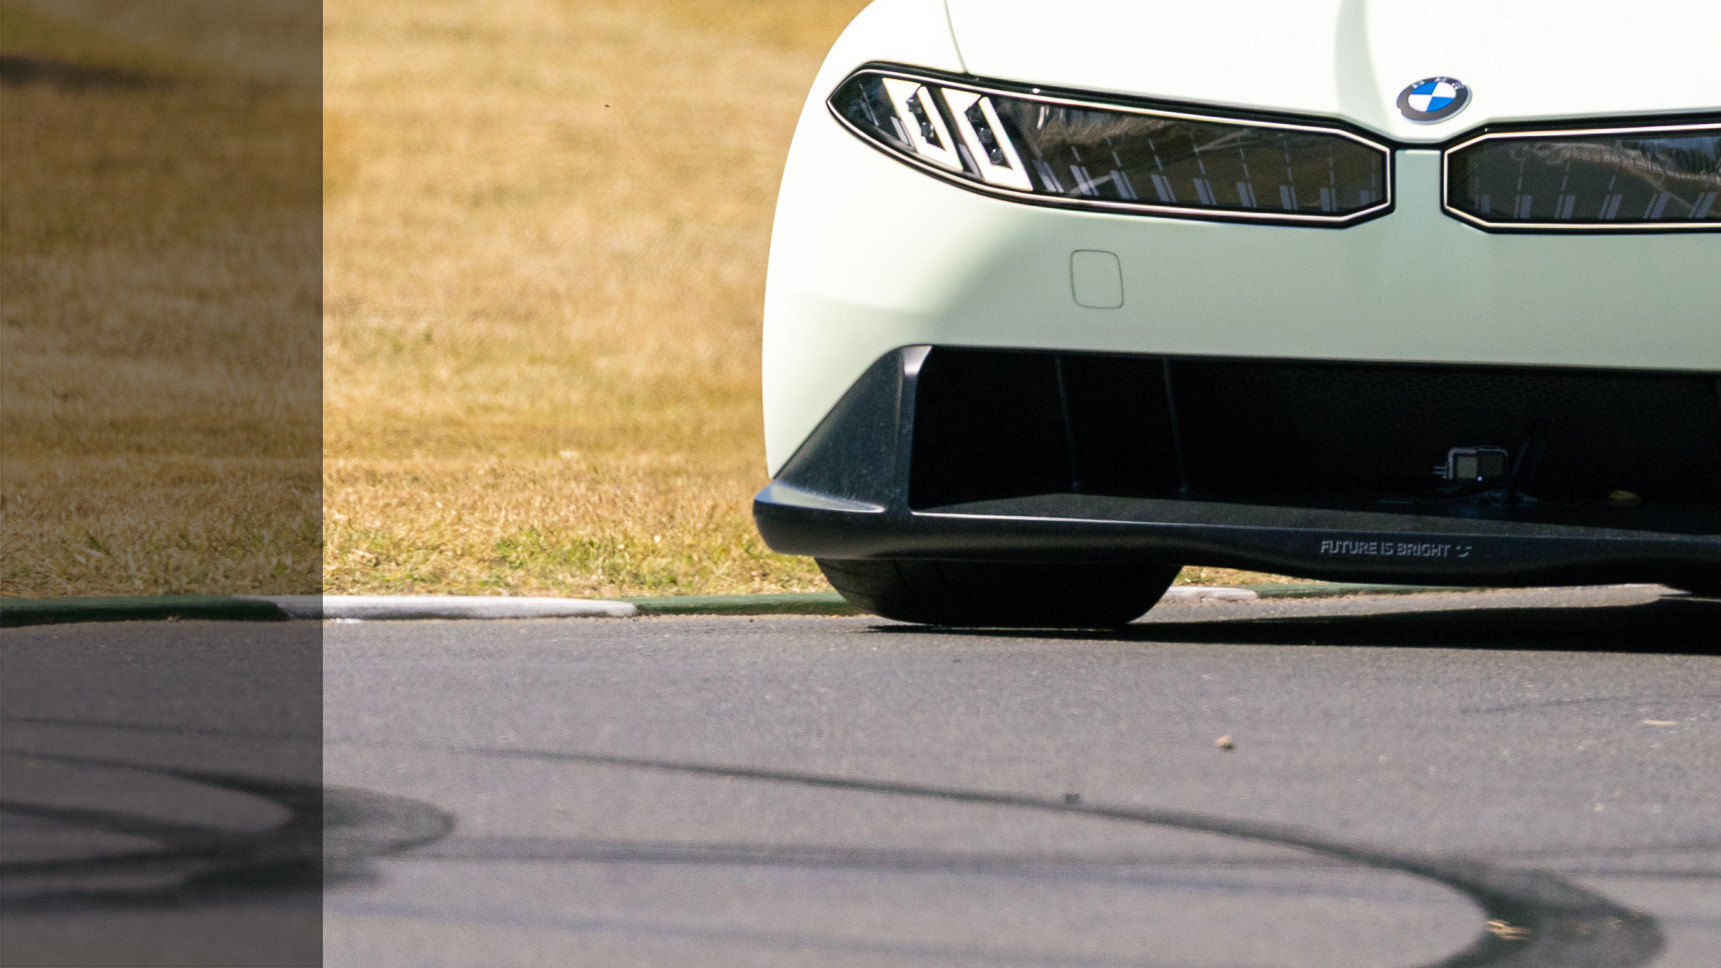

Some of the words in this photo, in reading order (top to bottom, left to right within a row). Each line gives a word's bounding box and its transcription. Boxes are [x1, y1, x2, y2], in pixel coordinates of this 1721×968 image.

[1320, 540, 1378, 555] FUTURE
[1380, 541, 1395, 556] IS
[1397, 542, 1451, 558] BRIGHT
